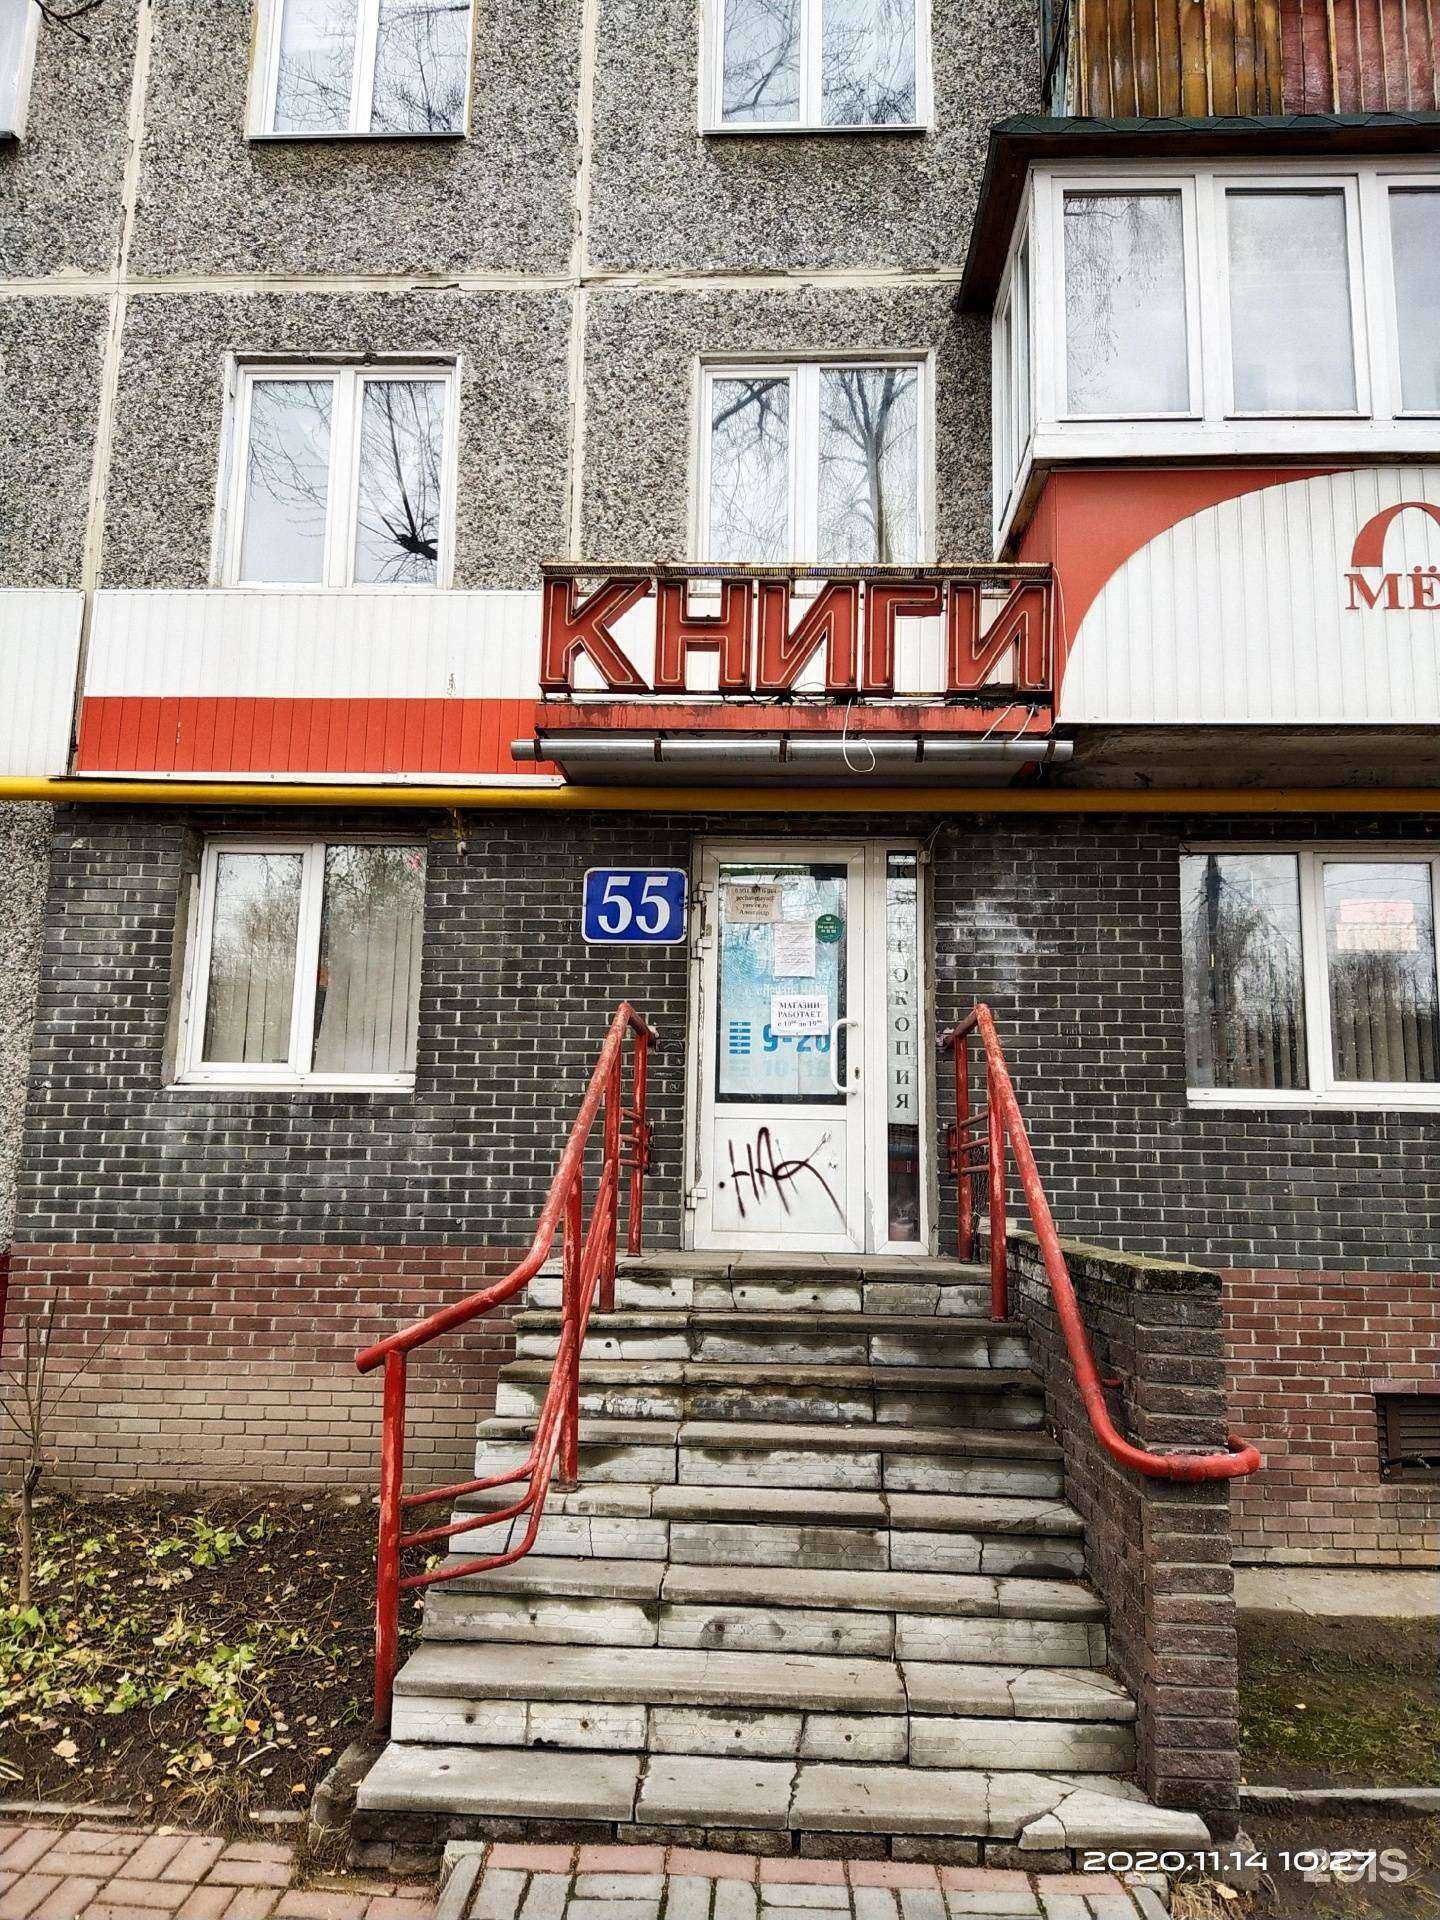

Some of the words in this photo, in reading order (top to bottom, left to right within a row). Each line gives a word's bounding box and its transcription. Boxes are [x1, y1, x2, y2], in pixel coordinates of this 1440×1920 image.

[539, 575, 1053, 694] КНИГИ
[597, 875, 671, 934] 55
[778, 1010, 822, 1018] РАБОТАЕТ
[779, 1001, 820, 1009] МАГАЗИН
